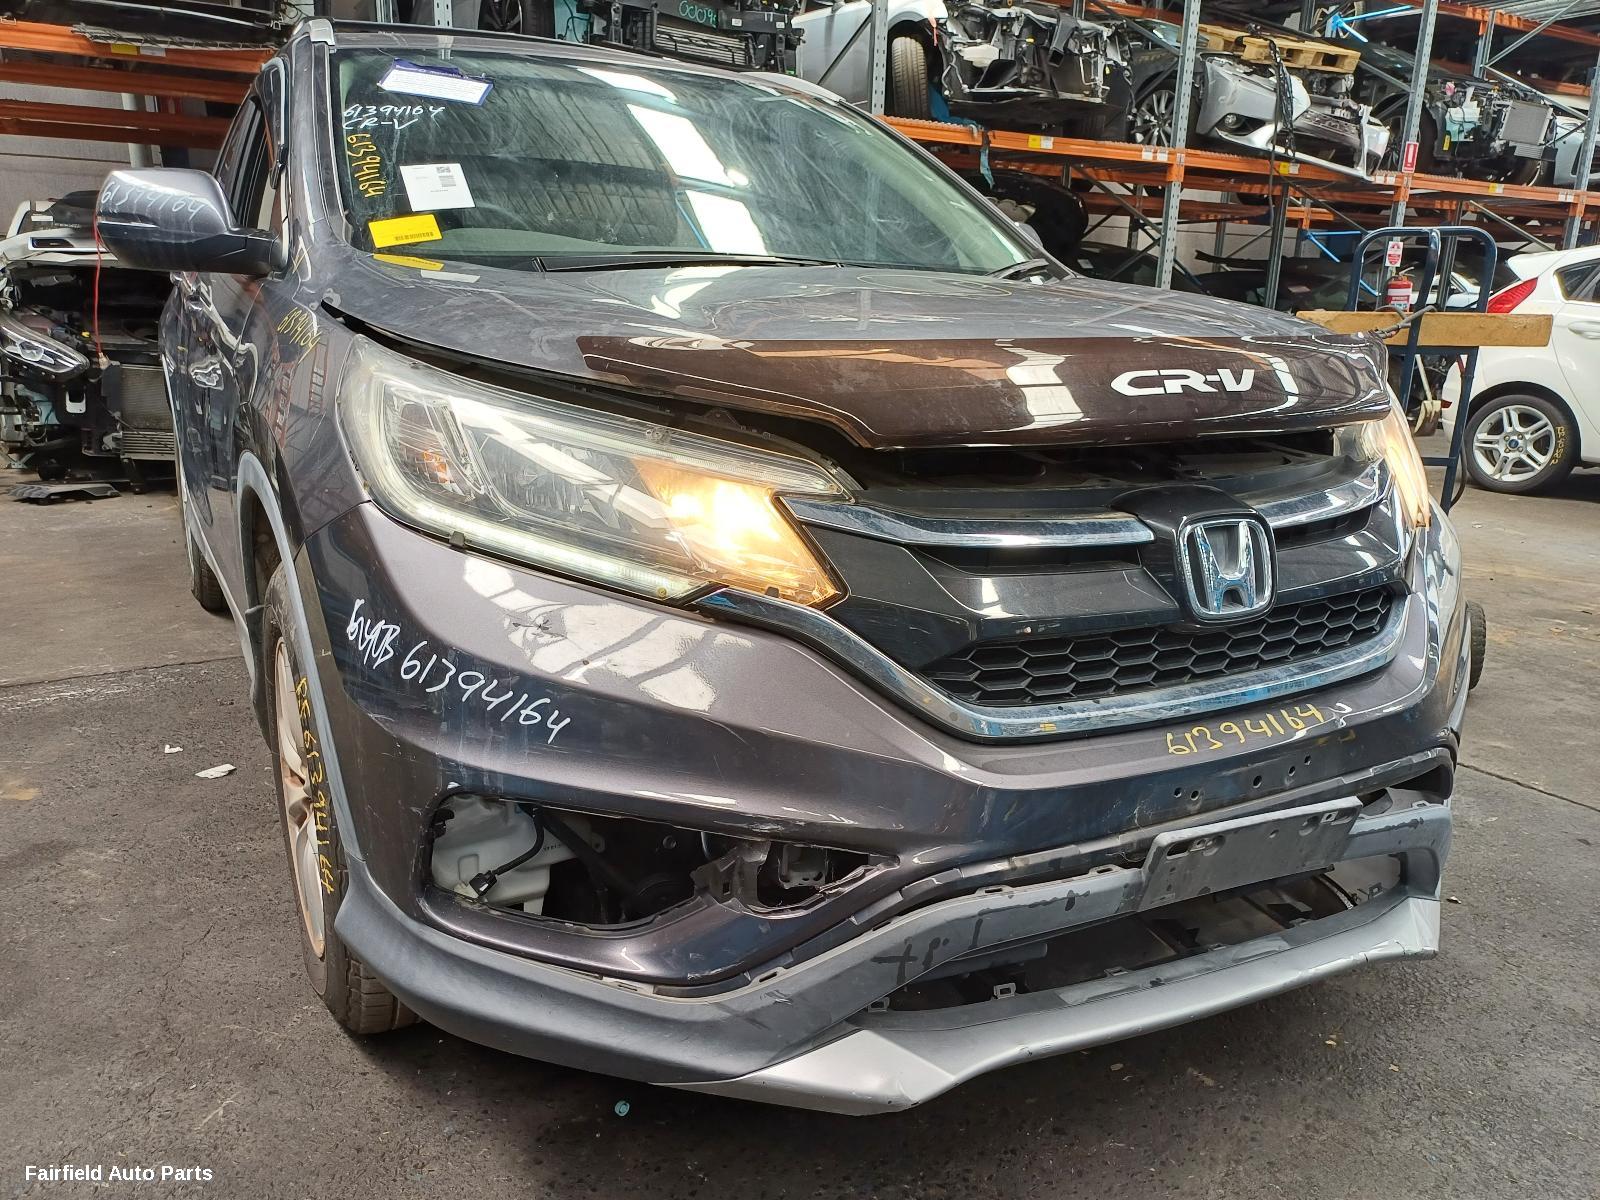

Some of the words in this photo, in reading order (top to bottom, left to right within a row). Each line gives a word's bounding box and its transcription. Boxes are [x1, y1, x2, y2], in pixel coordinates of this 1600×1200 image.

[342, 117, 419, 130] CR-V
[343, 103, 446, 121] 61394164
[346, 132, 387, 198] 61394164
[1110, 368, 1255, 397] CR-V
[400, 640, 571, 745] 61394164
[1166, 703, 1325, 756] 61394164
